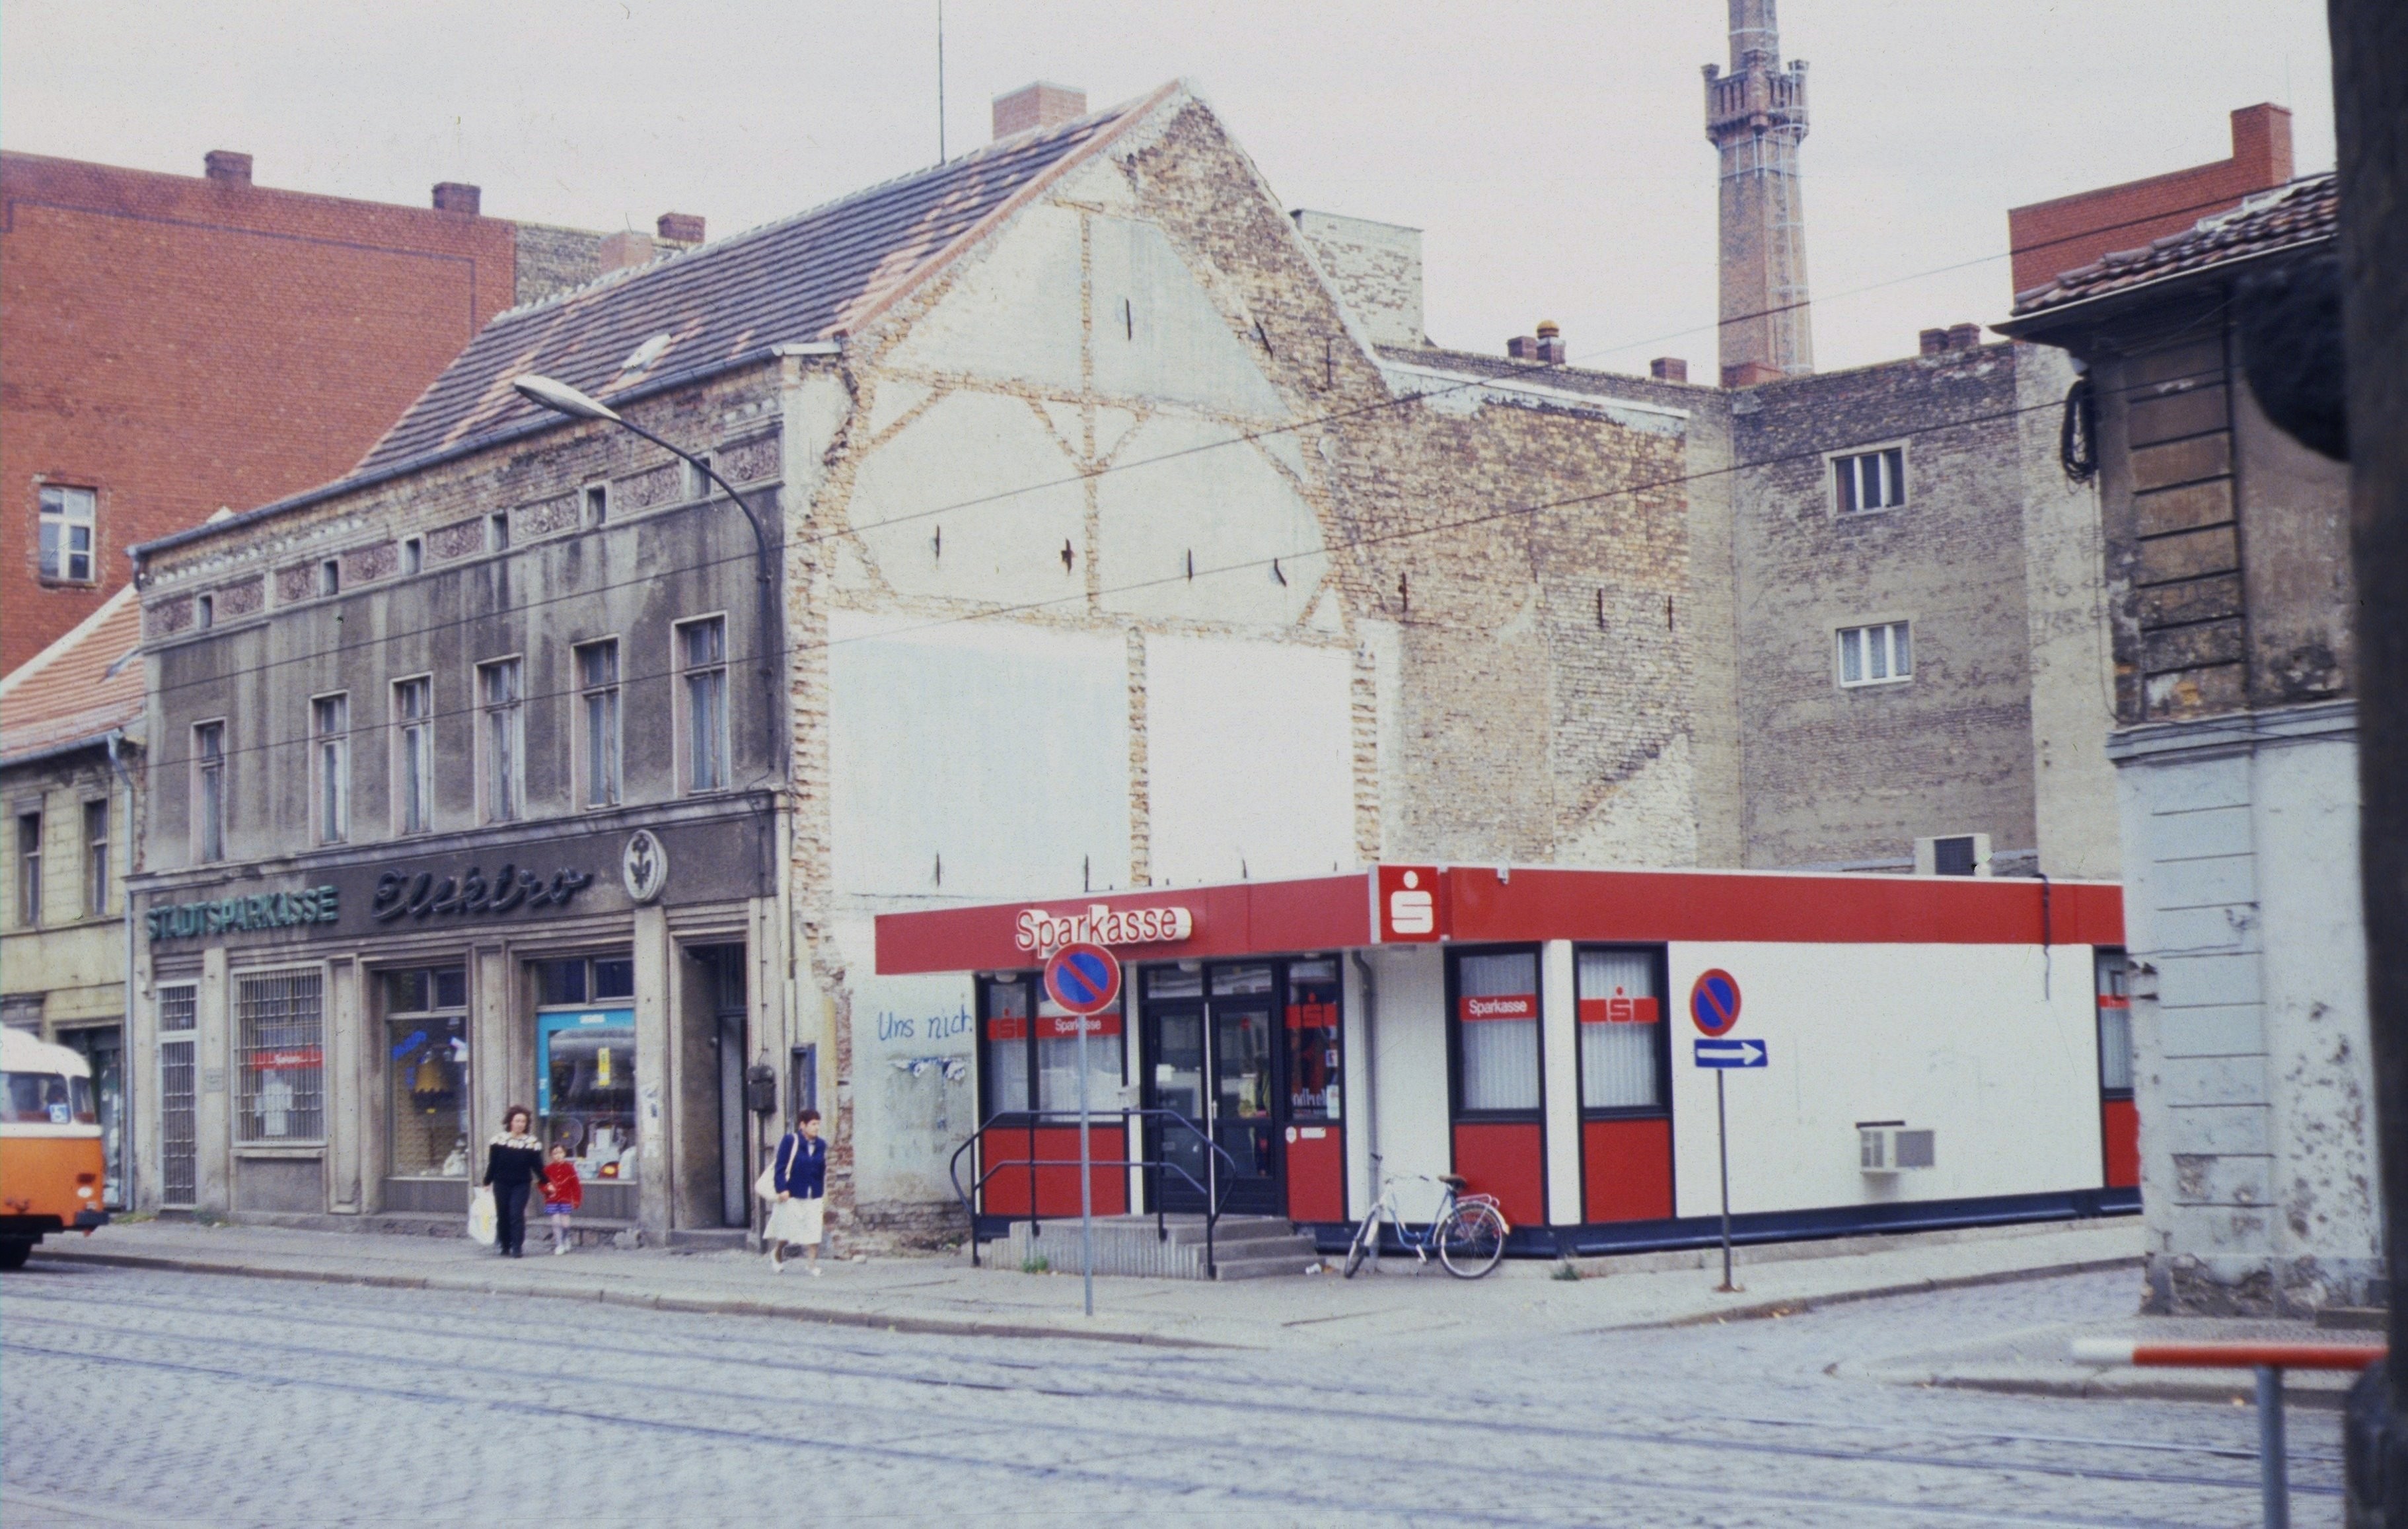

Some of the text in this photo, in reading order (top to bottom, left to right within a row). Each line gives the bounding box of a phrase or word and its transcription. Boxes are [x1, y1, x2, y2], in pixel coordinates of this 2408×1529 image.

[147, 886, 338, 939] STADTSPARKASSE
[372, 864, 593, 921] Elektro
[1016, 905, 1184, 959] Sparkasse
[878, 1011, 914, 1041] Uns
[1469, 999, 1527, 1016] Sparkasse
